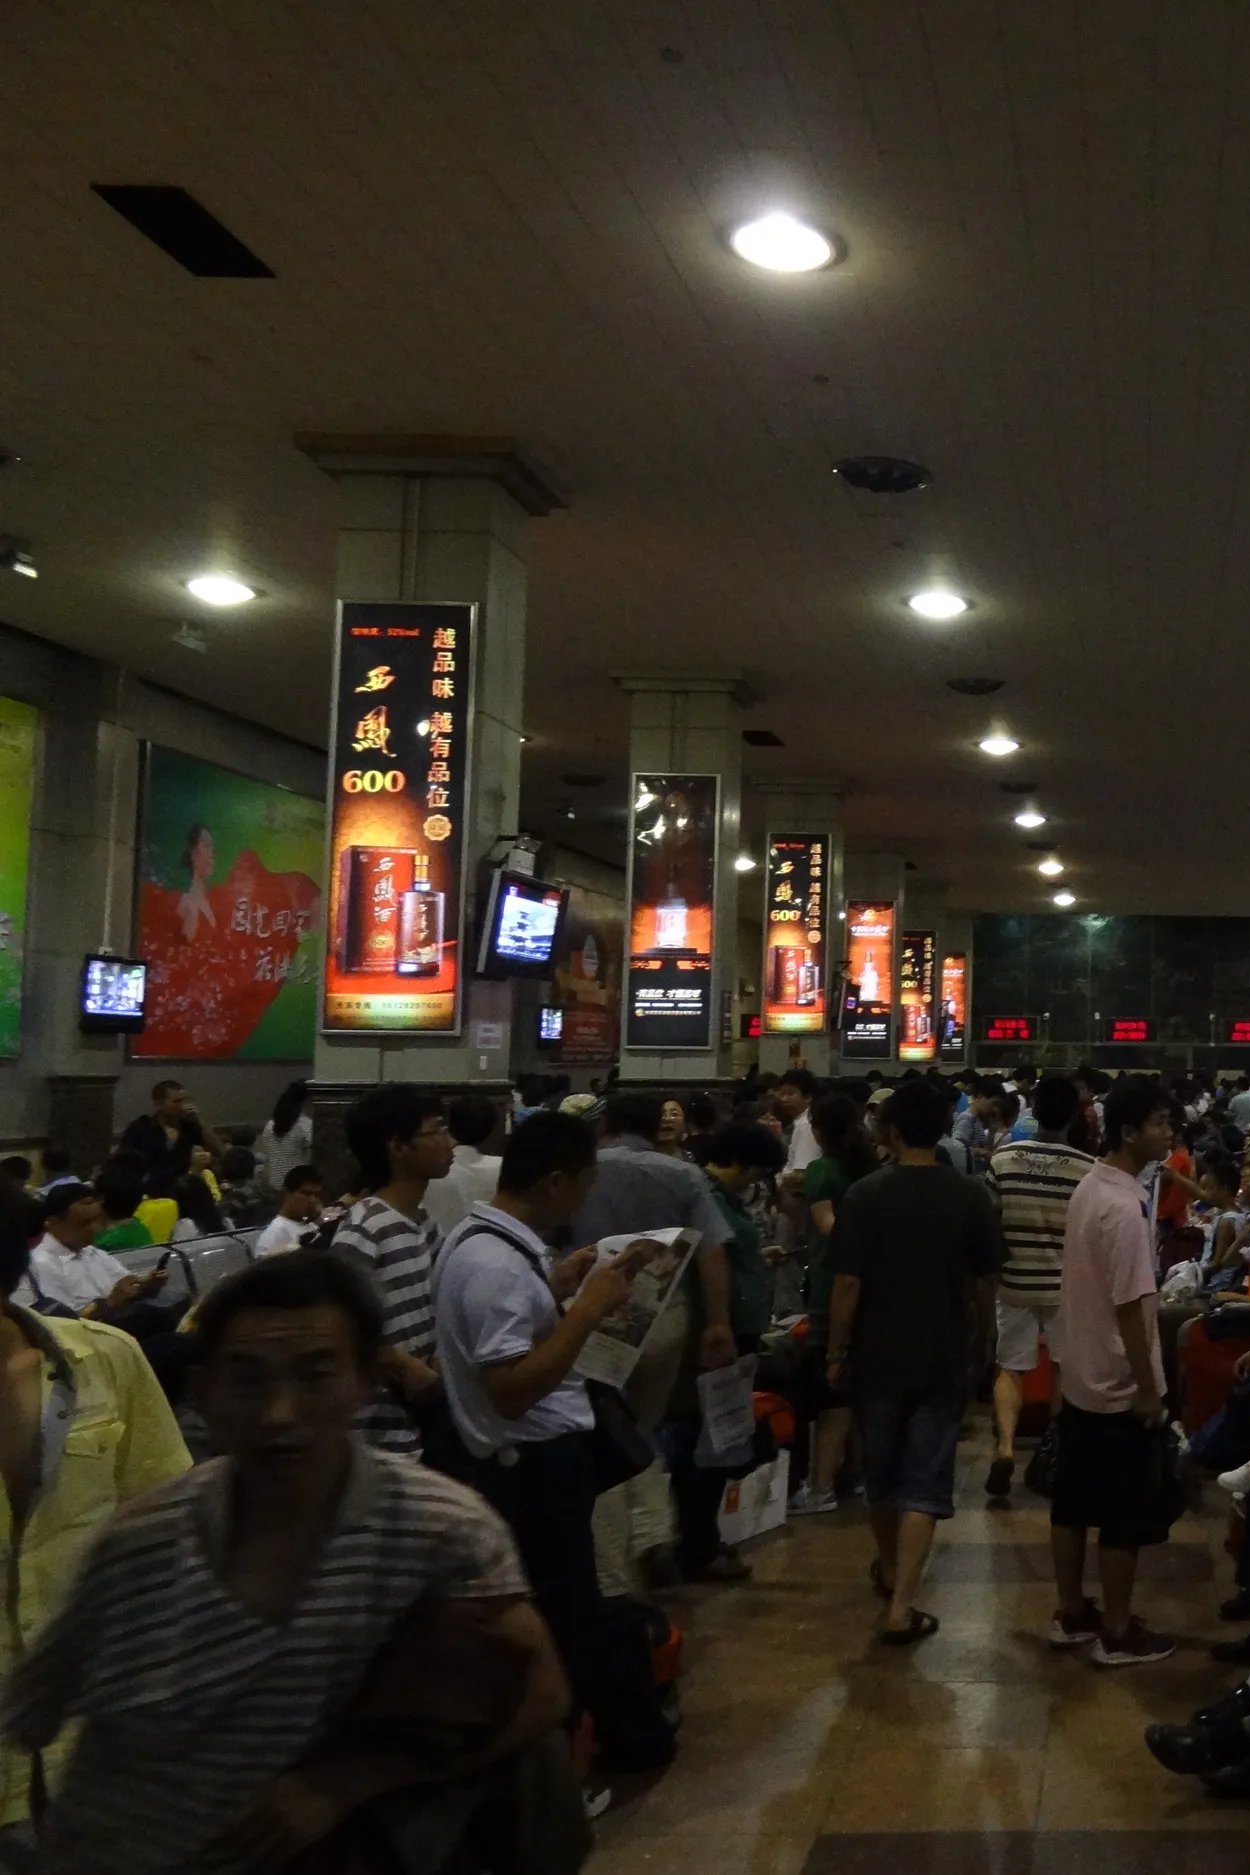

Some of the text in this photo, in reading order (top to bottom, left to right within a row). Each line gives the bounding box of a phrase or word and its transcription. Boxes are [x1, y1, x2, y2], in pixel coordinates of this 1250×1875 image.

[432, 627, 456, 698] 越品味
[342, 770, 406, 793] 600
[426, 711, 453, 808] 越有品位
[770, 910, 801, 921] 600
